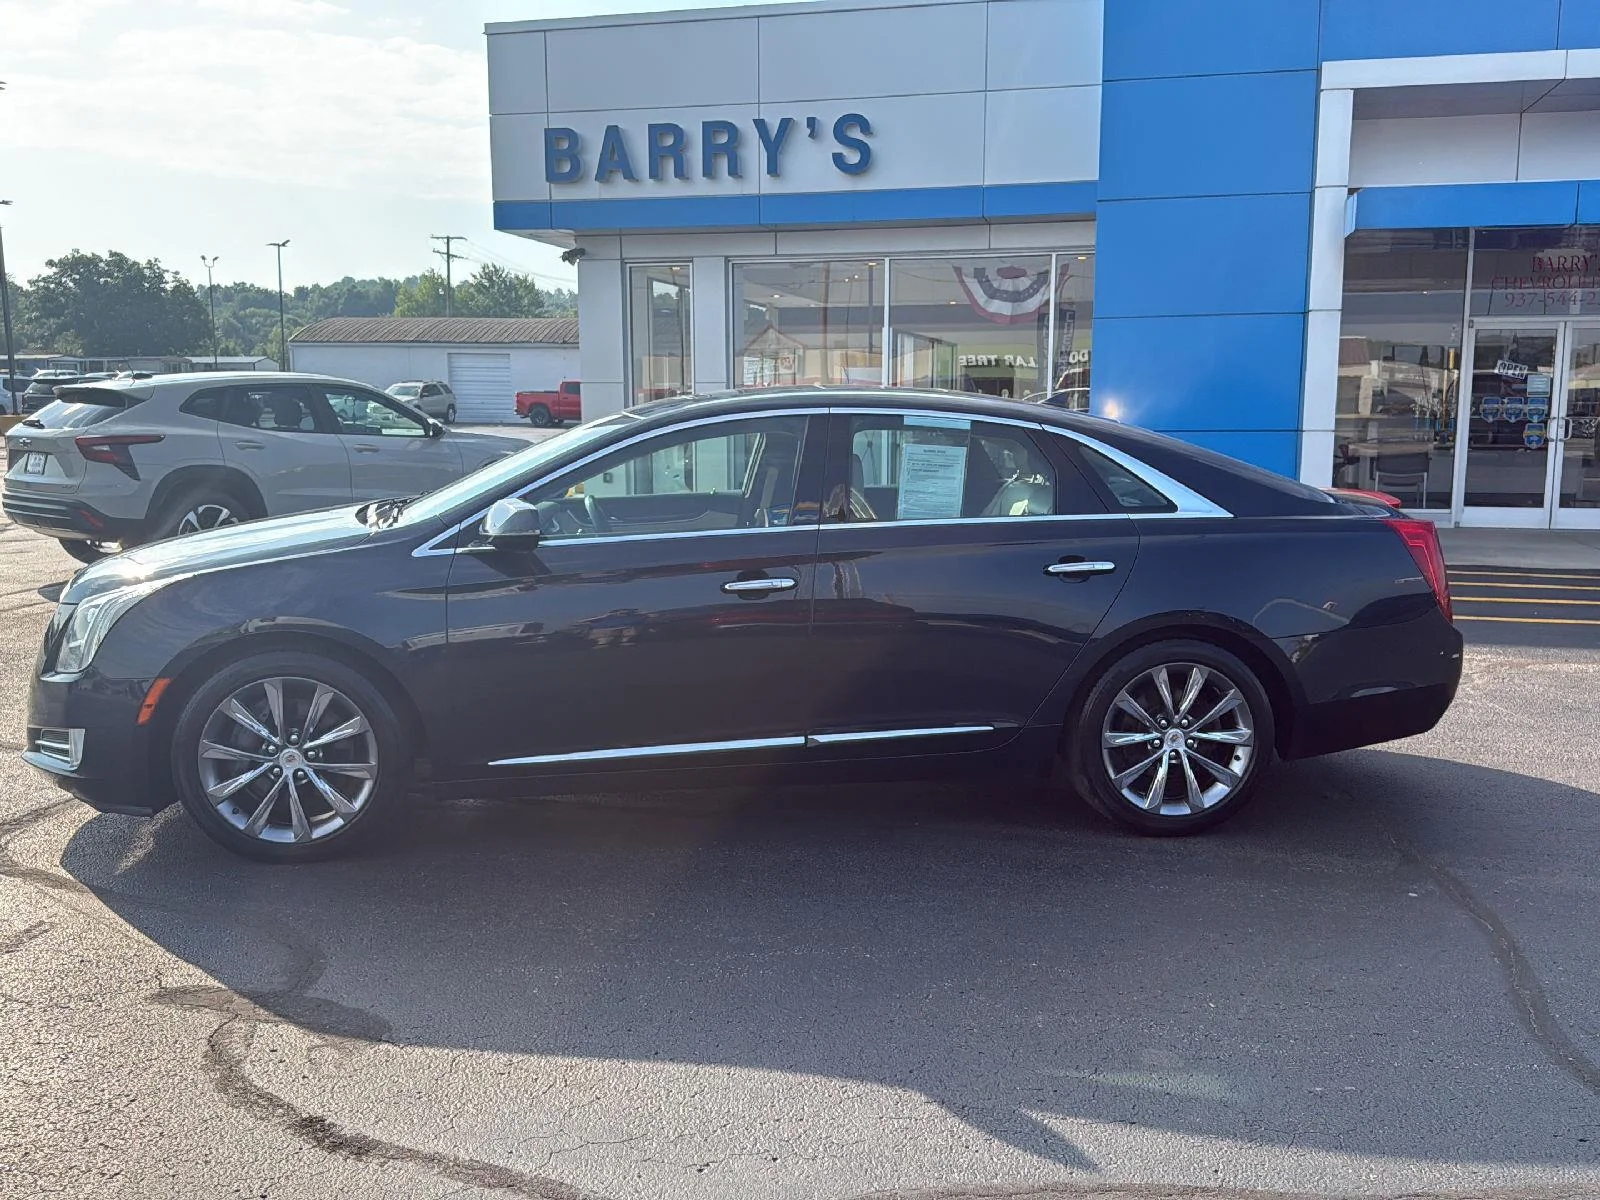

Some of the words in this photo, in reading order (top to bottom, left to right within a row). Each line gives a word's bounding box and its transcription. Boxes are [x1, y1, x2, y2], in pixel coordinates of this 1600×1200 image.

[543, 112, 873, 185] BARRY'S
[1532, 254, 1600, 273] BARRY'
[1504, 291, 1600, 308] 937-544-2
